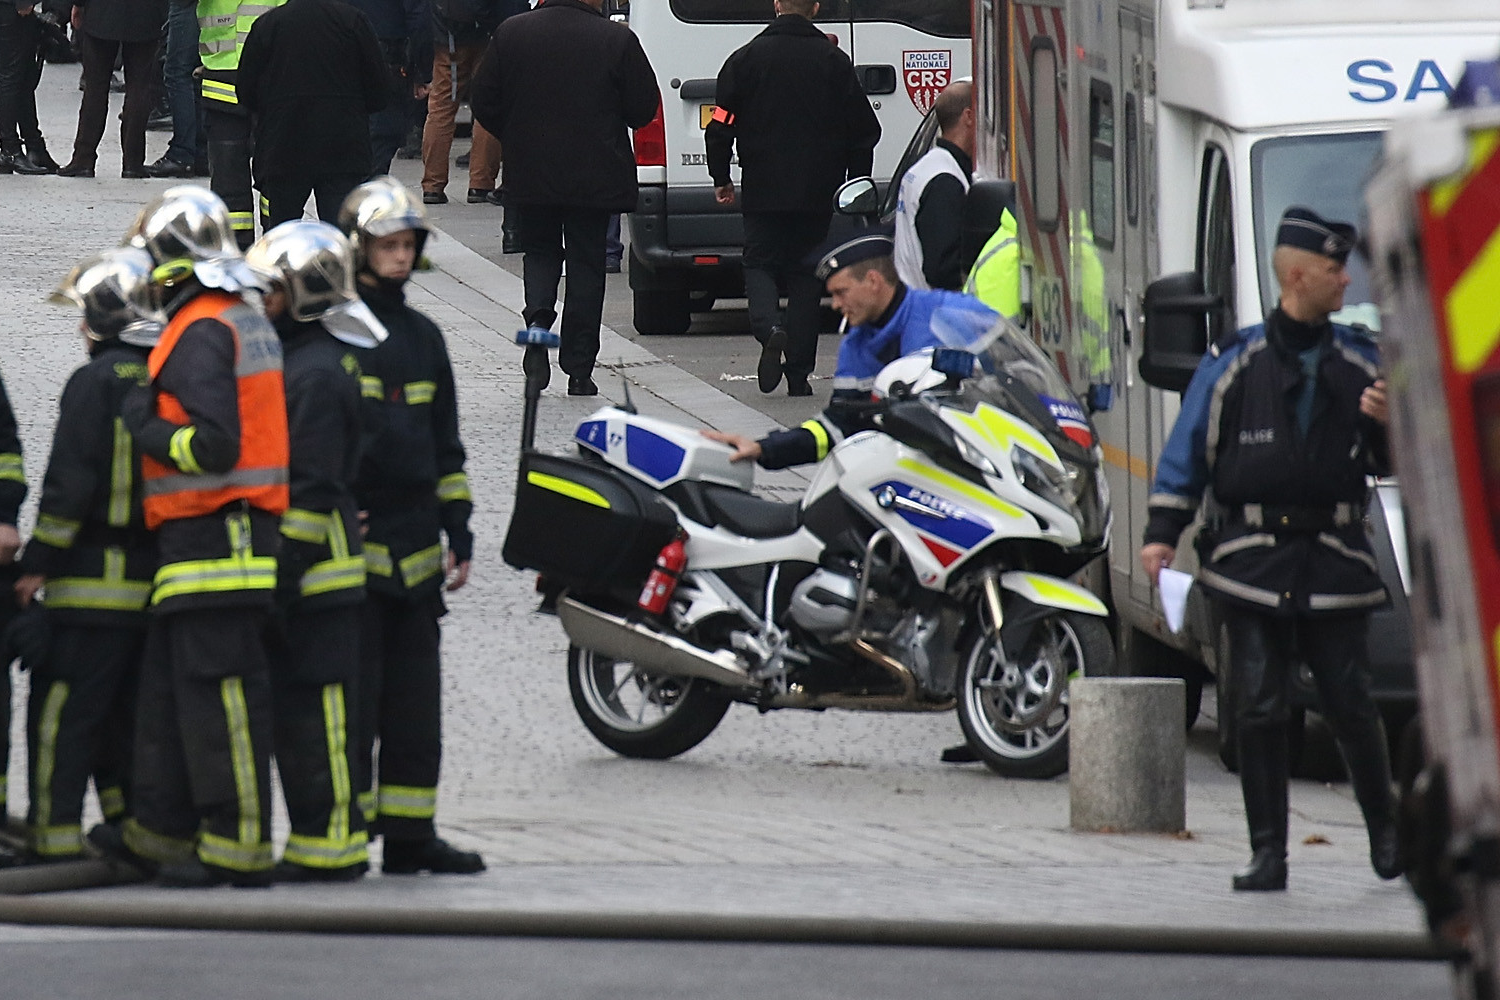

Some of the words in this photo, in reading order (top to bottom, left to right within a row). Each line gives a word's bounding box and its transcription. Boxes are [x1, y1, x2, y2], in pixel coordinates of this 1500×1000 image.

[909, 52, 945, 61] POLICE
[906, 61, 949, 69] NATIONALE
[907, 70, 948, 87] CRS
[1239, 429, 1274, 445] OLICE
